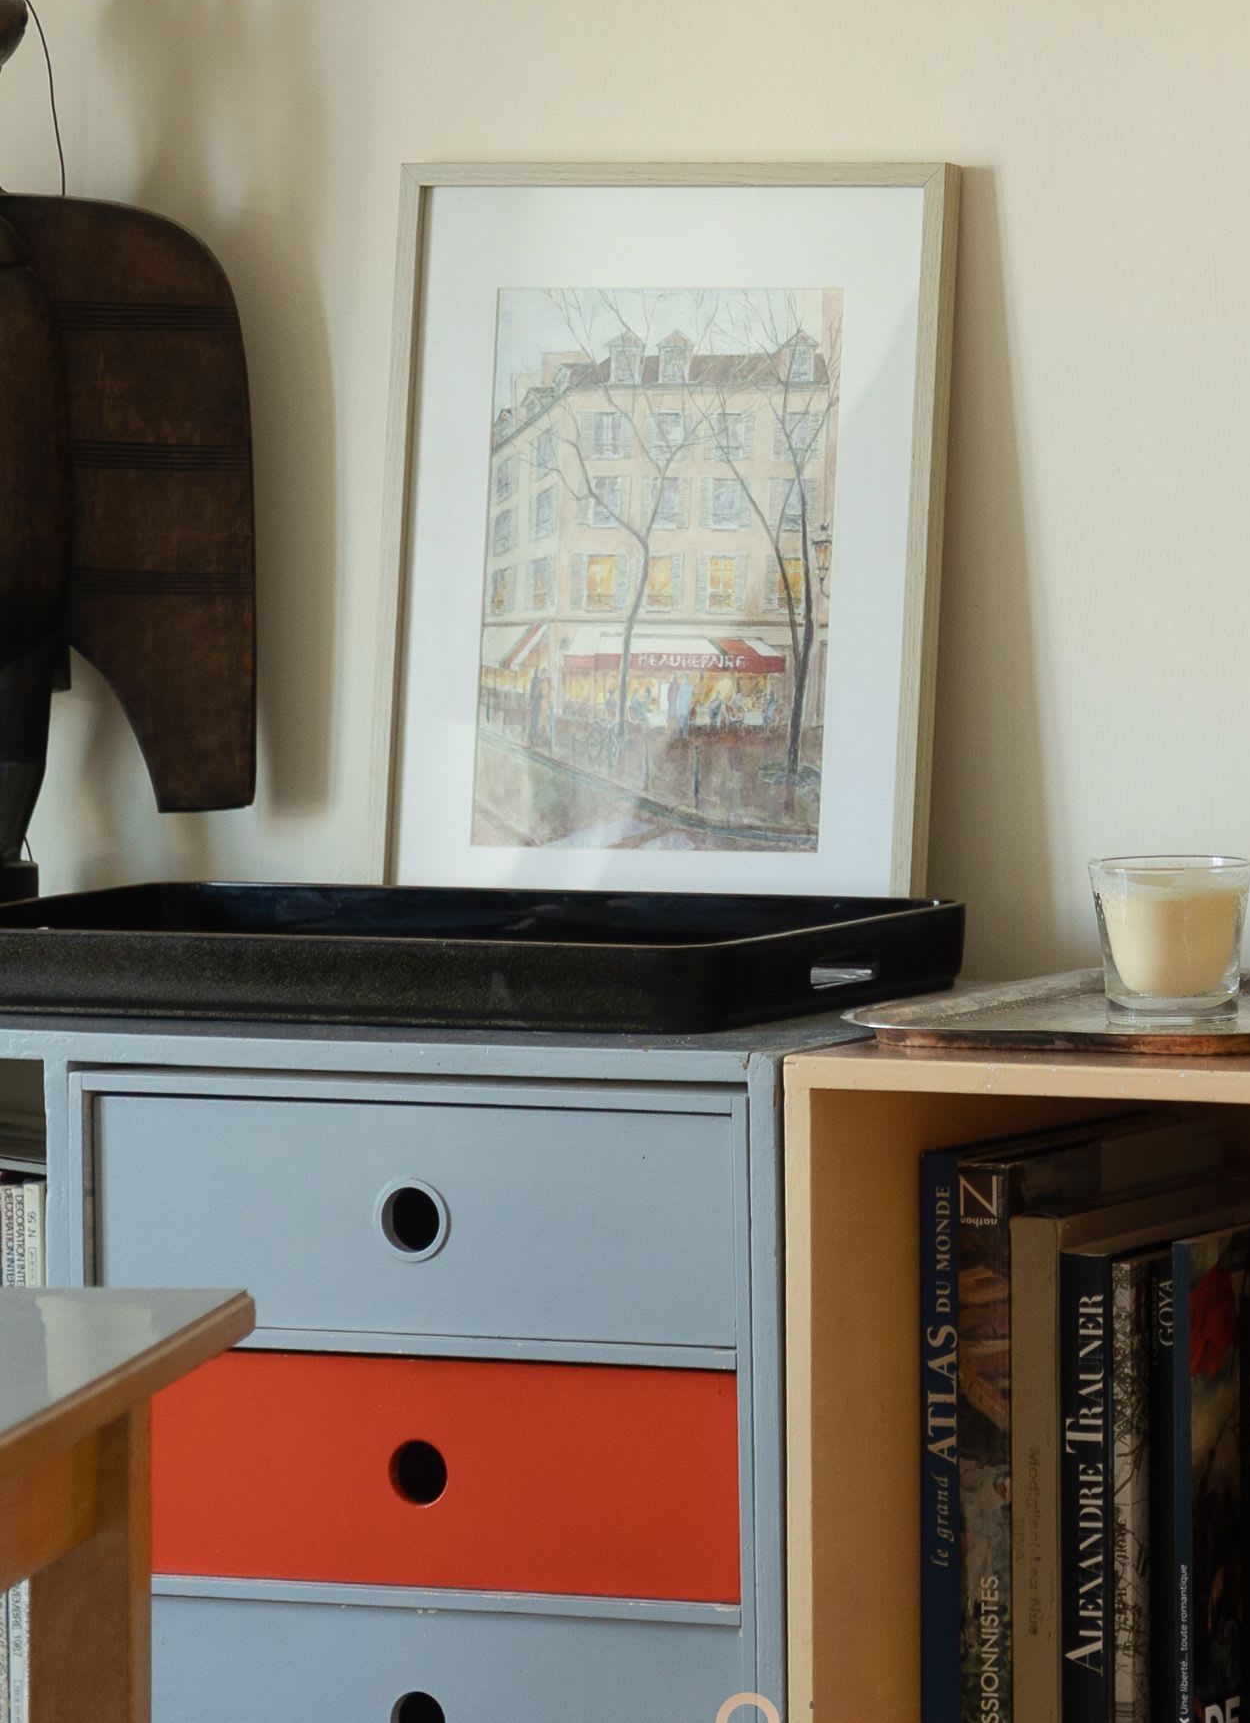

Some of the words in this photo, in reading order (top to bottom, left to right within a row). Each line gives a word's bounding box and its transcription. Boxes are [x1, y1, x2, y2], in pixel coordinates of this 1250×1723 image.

[934, 1186, 951, 1271] MONDE
[935, 1280, 951, 1313] DU
[1158, 1280, 1173, 1346] GOYA
[926, 1325, 957, 1466] ATLAS
[1065, 1292, 1104, 1454] TRAUNER
[931, 1472, 954, 1543] grand
[930, 1549, 949, 1567] le
[1064, 1463, 1104, 1677] ALEXANDRE
[1179, 1564, 1191, 1622] romantique
[980, 1576, 999, 1723] SSIONNISTES
[1179, 1625, 1188, 1651] toute
[1179, 1695, 1188, 1715] Une
